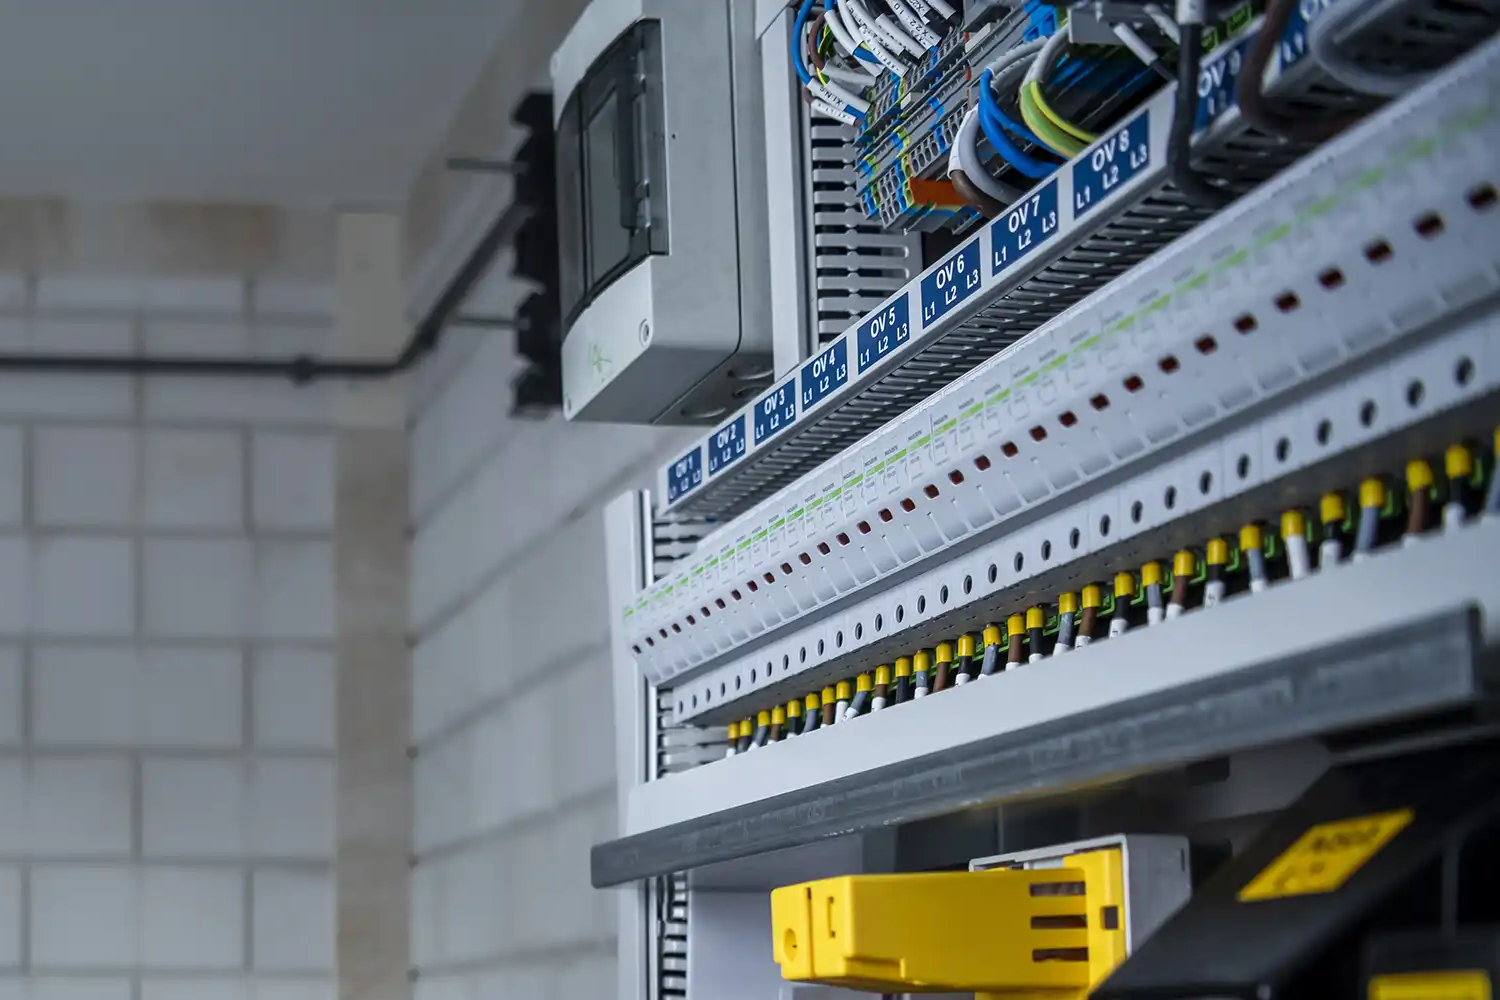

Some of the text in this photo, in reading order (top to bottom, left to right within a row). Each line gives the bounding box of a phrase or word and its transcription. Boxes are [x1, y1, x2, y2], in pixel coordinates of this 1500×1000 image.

[1197, 57, 1226, 98] OV
[1092, 129, 1130, 172] OV 8
[1076, 143, 1147, 209] L1 L2 L3
[1008, 194, 1041, 233] OV 7
[995, 211, 1056, 267] L1 L2 L3
[936, 254, 964, 289] OV 6
[924, 269, 979, 321] L1 L2 L3
[870, 306, 896, 338] OV 5
[813, 348, 835, 378] OV 4
[860, 322, 908, 367] L1 L2 L3
[764, 388, 785, 415] OV 3
[803, 364, 846, 404] L1 L2 L3
[717, 424, 736, 448] OV 2
[756, 404, 794, 439] L1 L2 L3
[710, 438, 744, 471] L1 L2 L3
